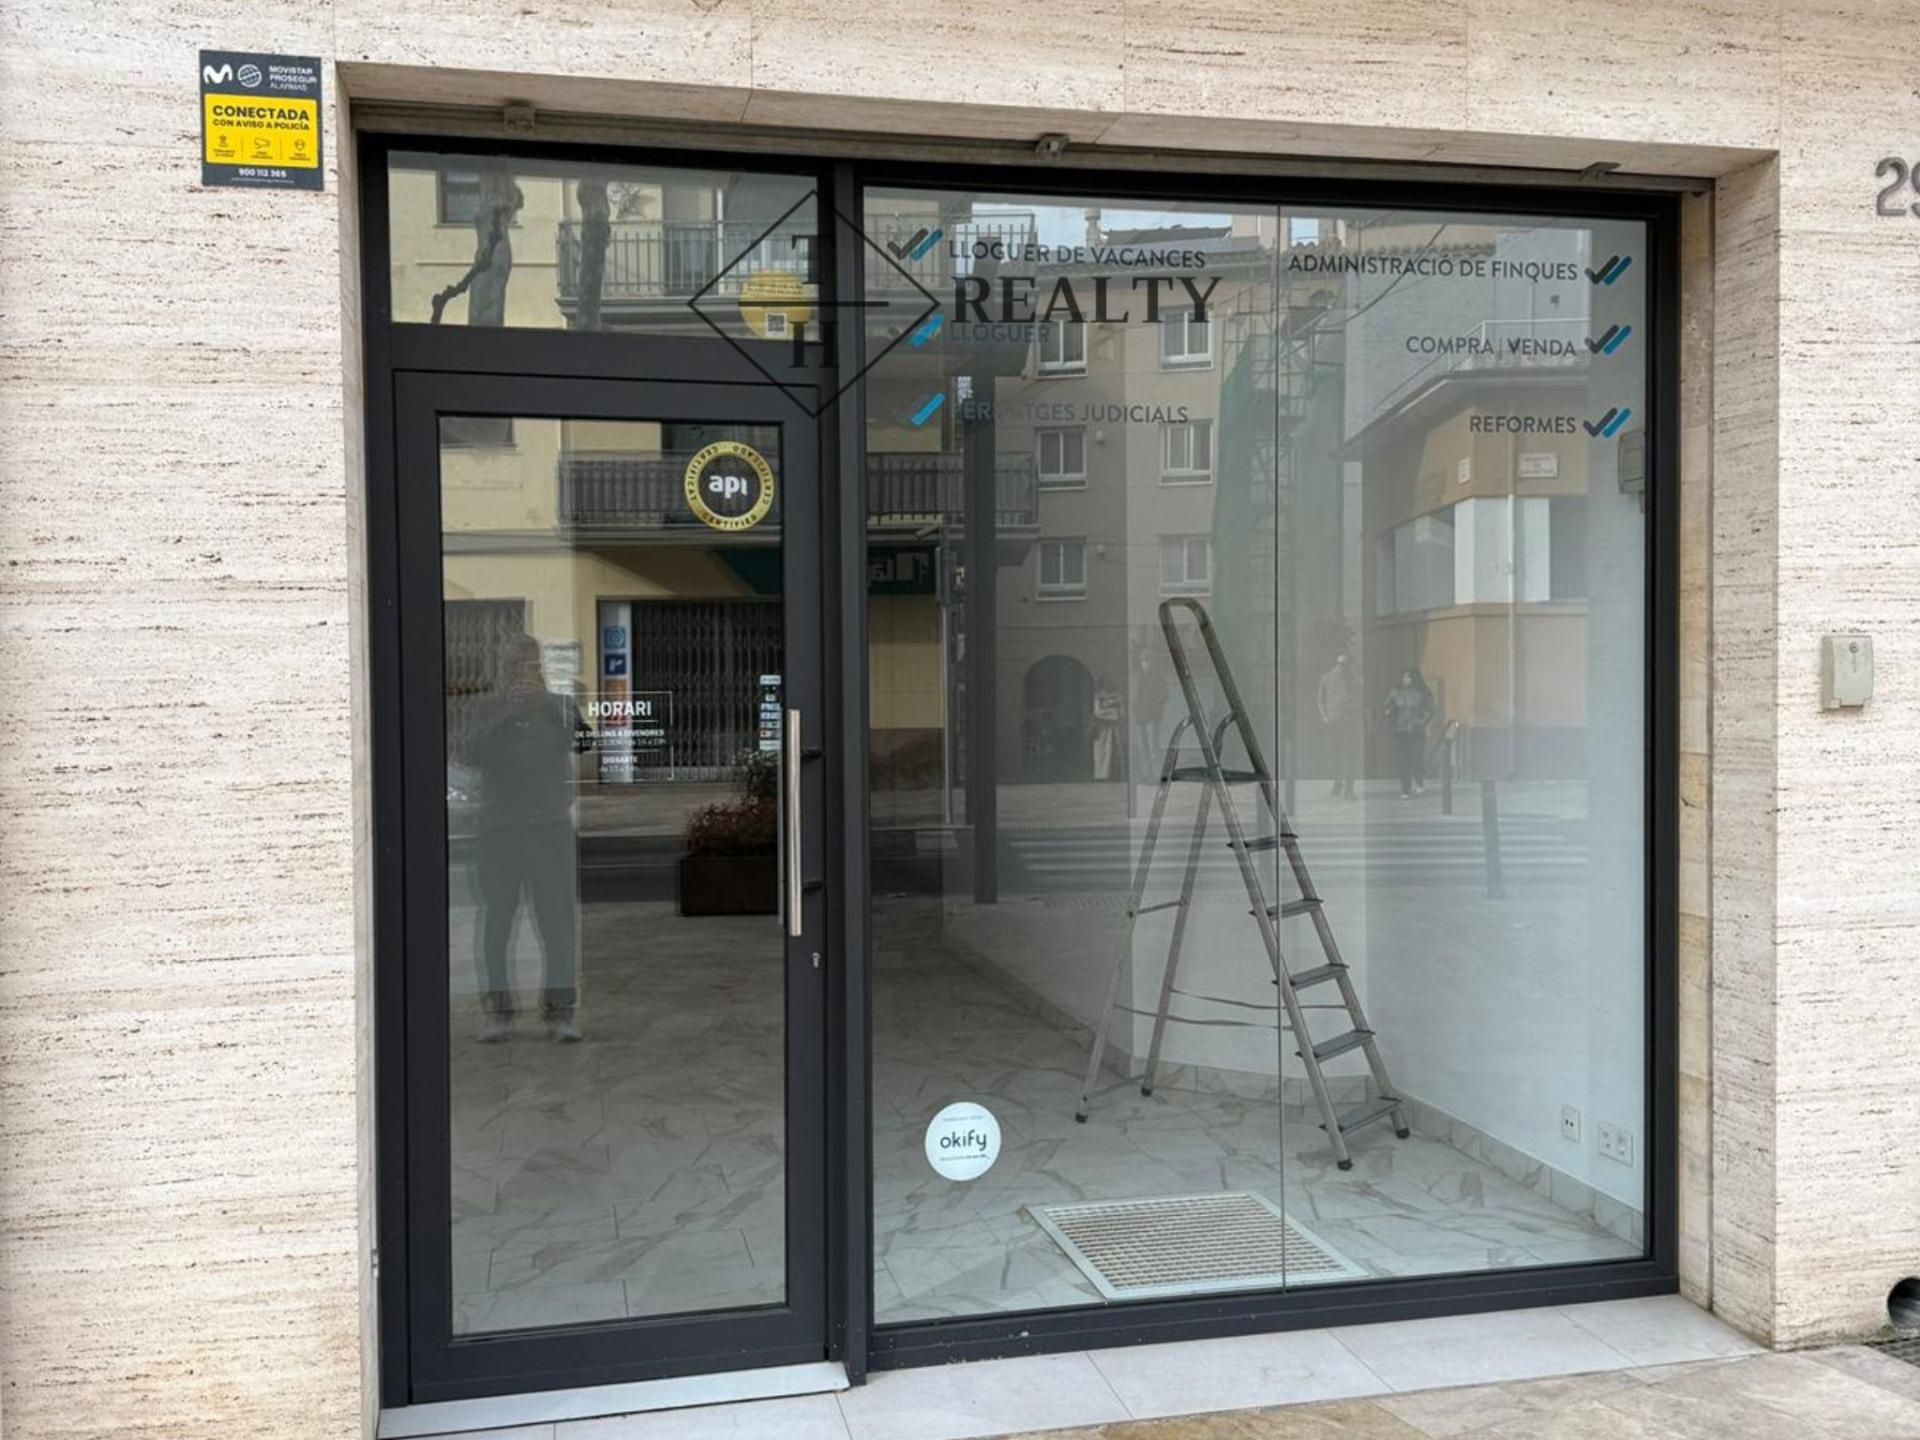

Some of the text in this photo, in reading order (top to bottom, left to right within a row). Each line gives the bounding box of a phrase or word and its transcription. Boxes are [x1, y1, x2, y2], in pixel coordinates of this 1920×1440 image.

[269, 66, 313, 75] MOVISTAR
[269, 74, 317, 84] PROSEGUR
[212, 105, 309, 121] CONECTADA
[213, 119, 235, 127] CON
[236, 120, 264, 129] AVISO
[274, 121, 310, 131] POLICÍA
[239, 168, 256, 177] 900
[948, 241, 1206, 269] LLOGUER DE VACANCES
[1288, 252, 1577, 282] ADMINISTRACIÓ DE FINQUES
[1406, 336, 1577, 356] COMPRA VENDA
[1079, 403, 1189, 424] JUDICIALS
[1469, 416, 1577, 434] REFORMES
[708, 475, 748, 499] api
[588, 701, 652, 717] HORARI
[940, 1129, 987, 1152] okify
